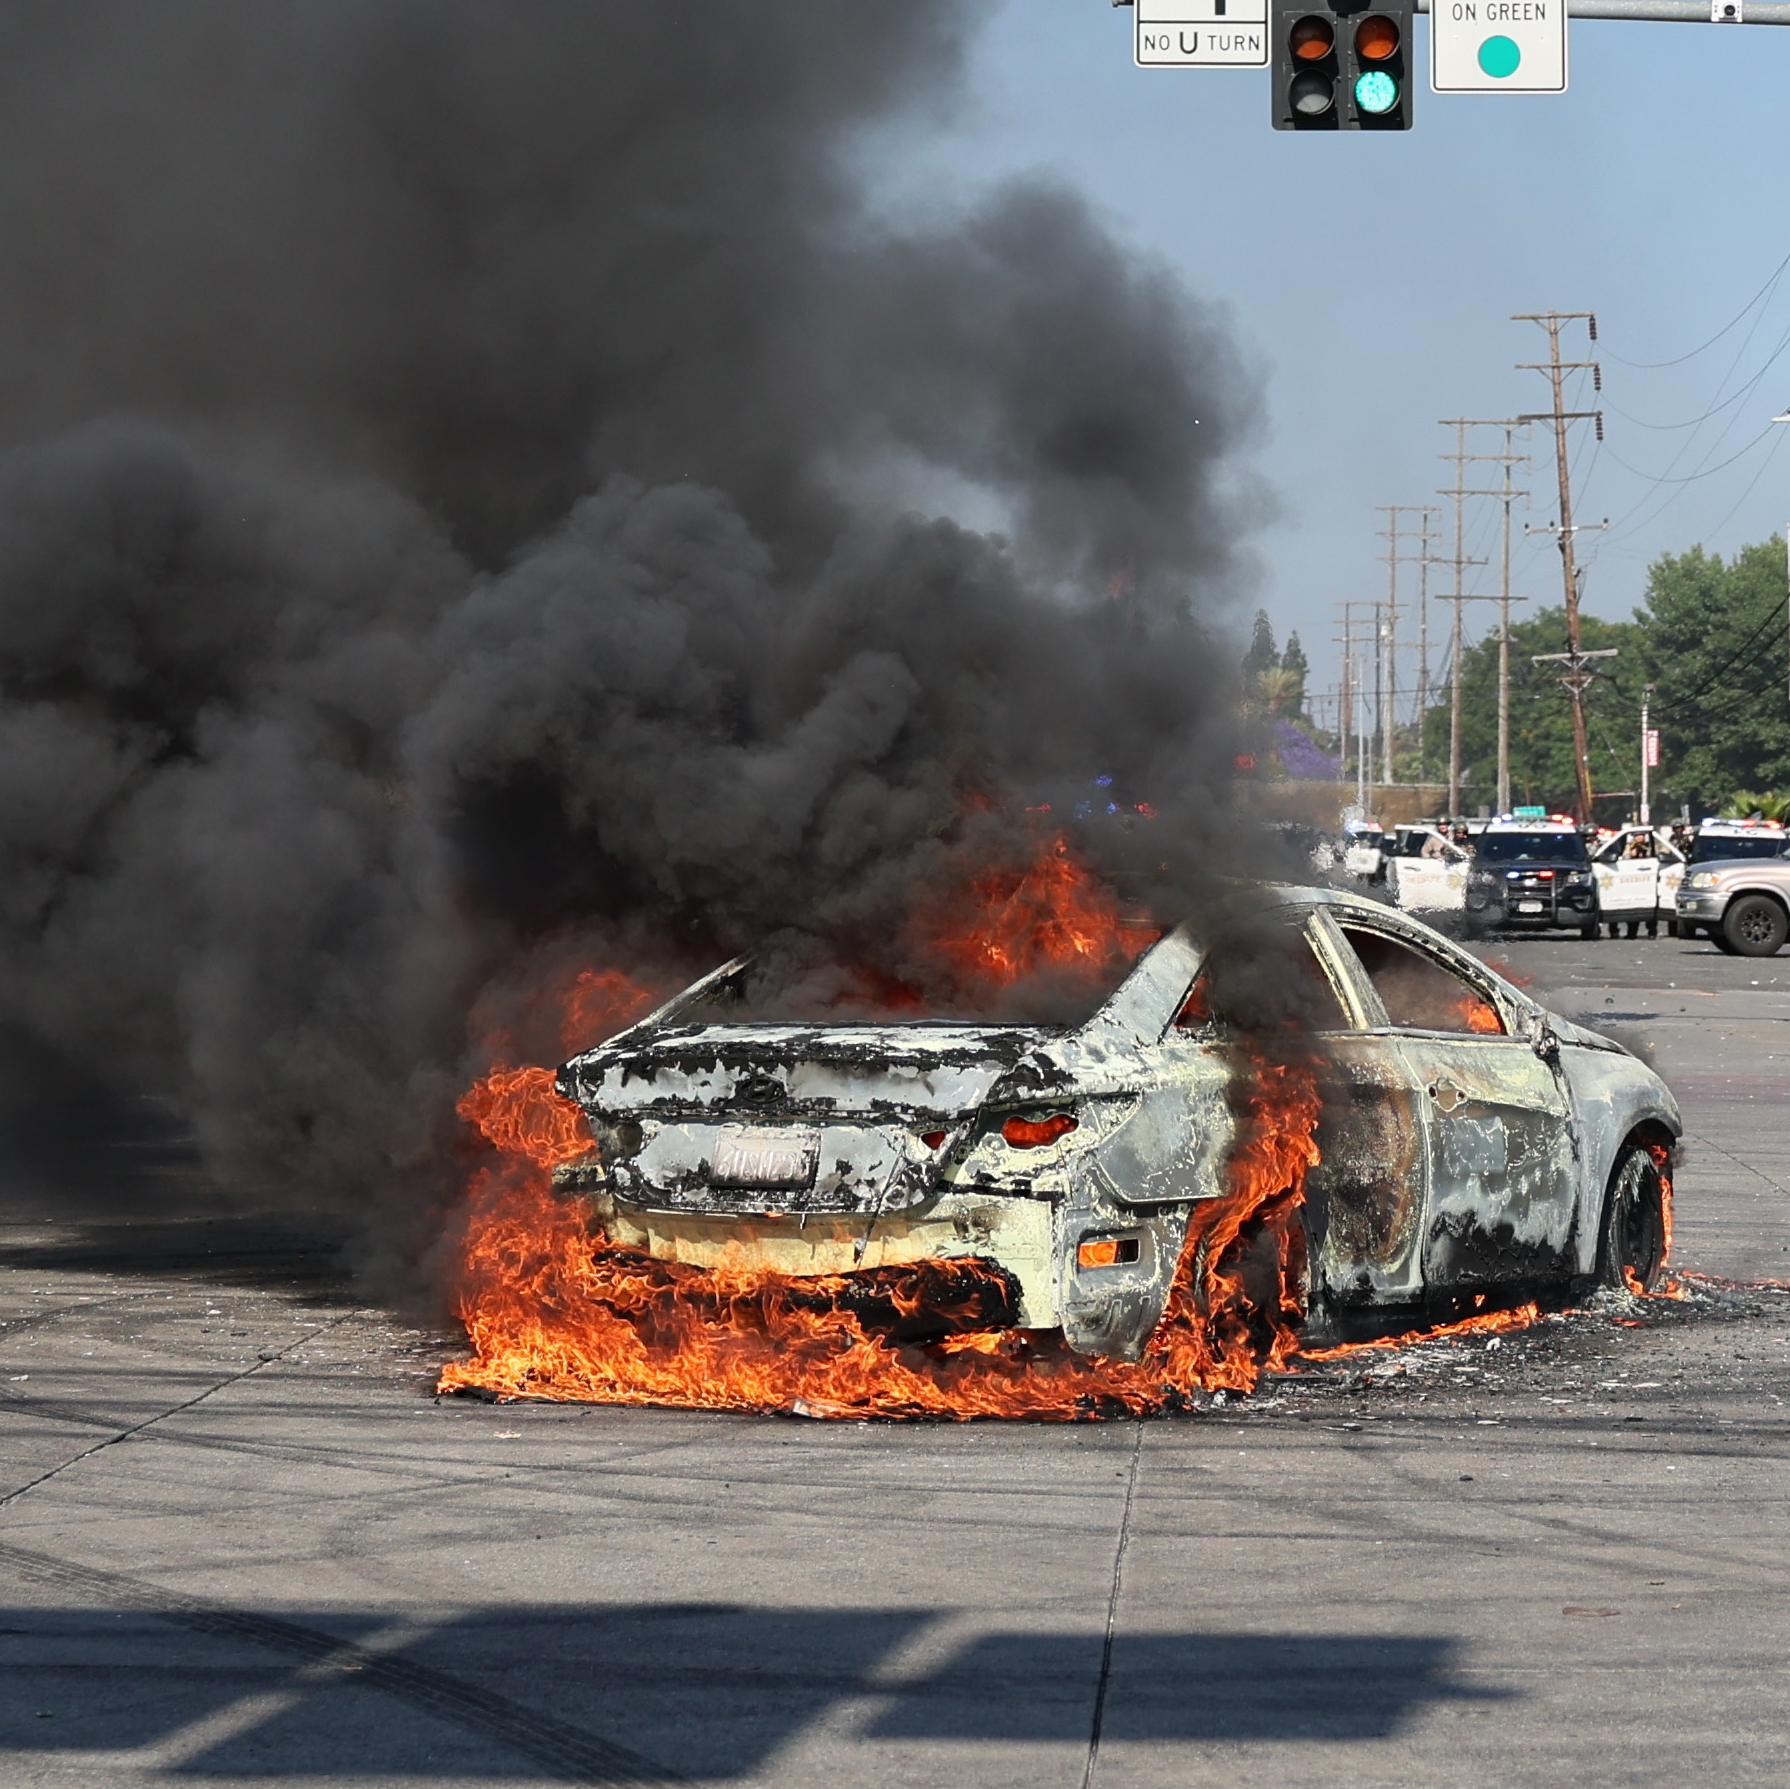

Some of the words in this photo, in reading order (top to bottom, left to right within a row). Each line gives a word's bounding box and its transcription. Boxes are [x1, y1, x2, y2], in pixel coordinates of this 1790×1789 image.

[1452, 3, 1478, 21] ON
[1486, 2, 1546, 21] GREEN
[1144, 35, 1170, 52] NO
[1179, 32, 1198, 55] U
[1208, 34, 1260, 52] TURN
[1620, 875, 1651, 883] SHERIFF
